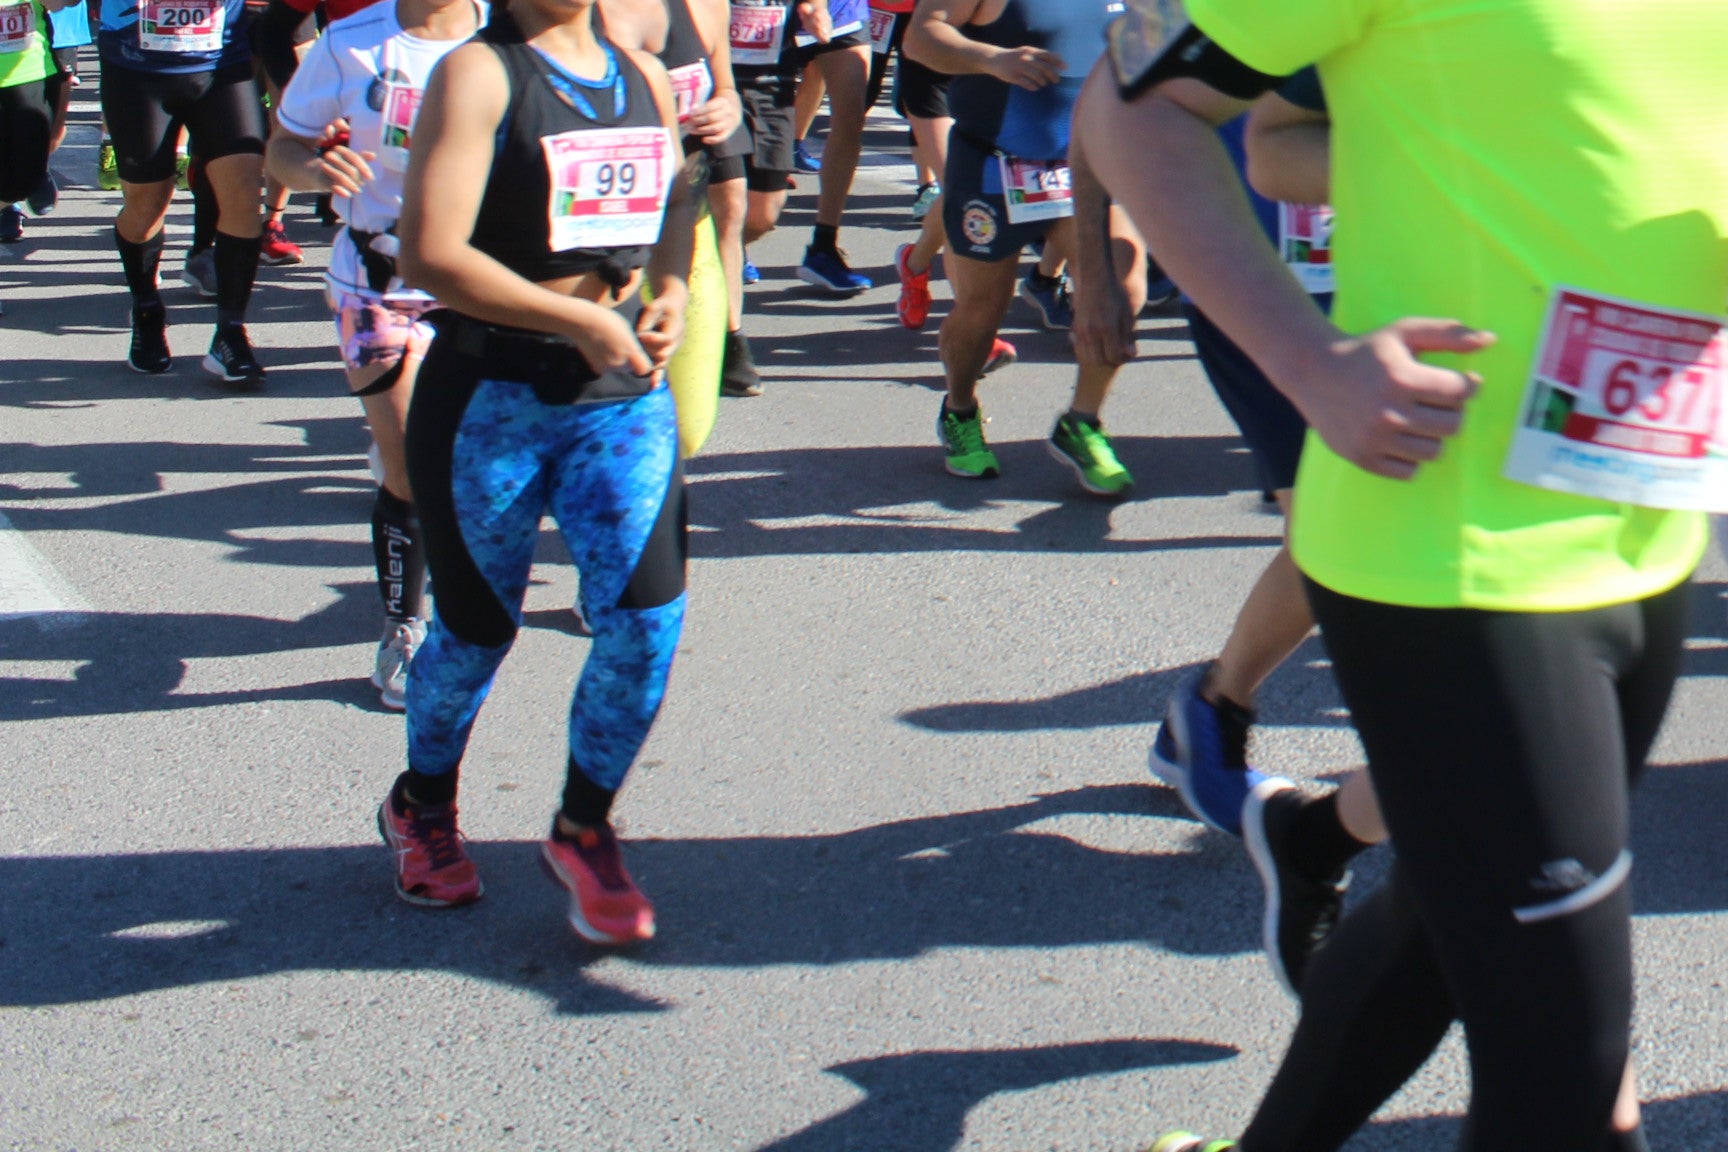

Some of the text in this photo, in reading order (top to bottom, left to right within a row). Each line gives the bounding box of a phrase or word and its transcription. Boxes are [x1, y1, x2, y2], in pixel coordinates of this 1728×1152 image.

[163, 8, 205, 26] 200
[596, 162, 637, 197] 99
[1602, 359, 1704, 426] 637
